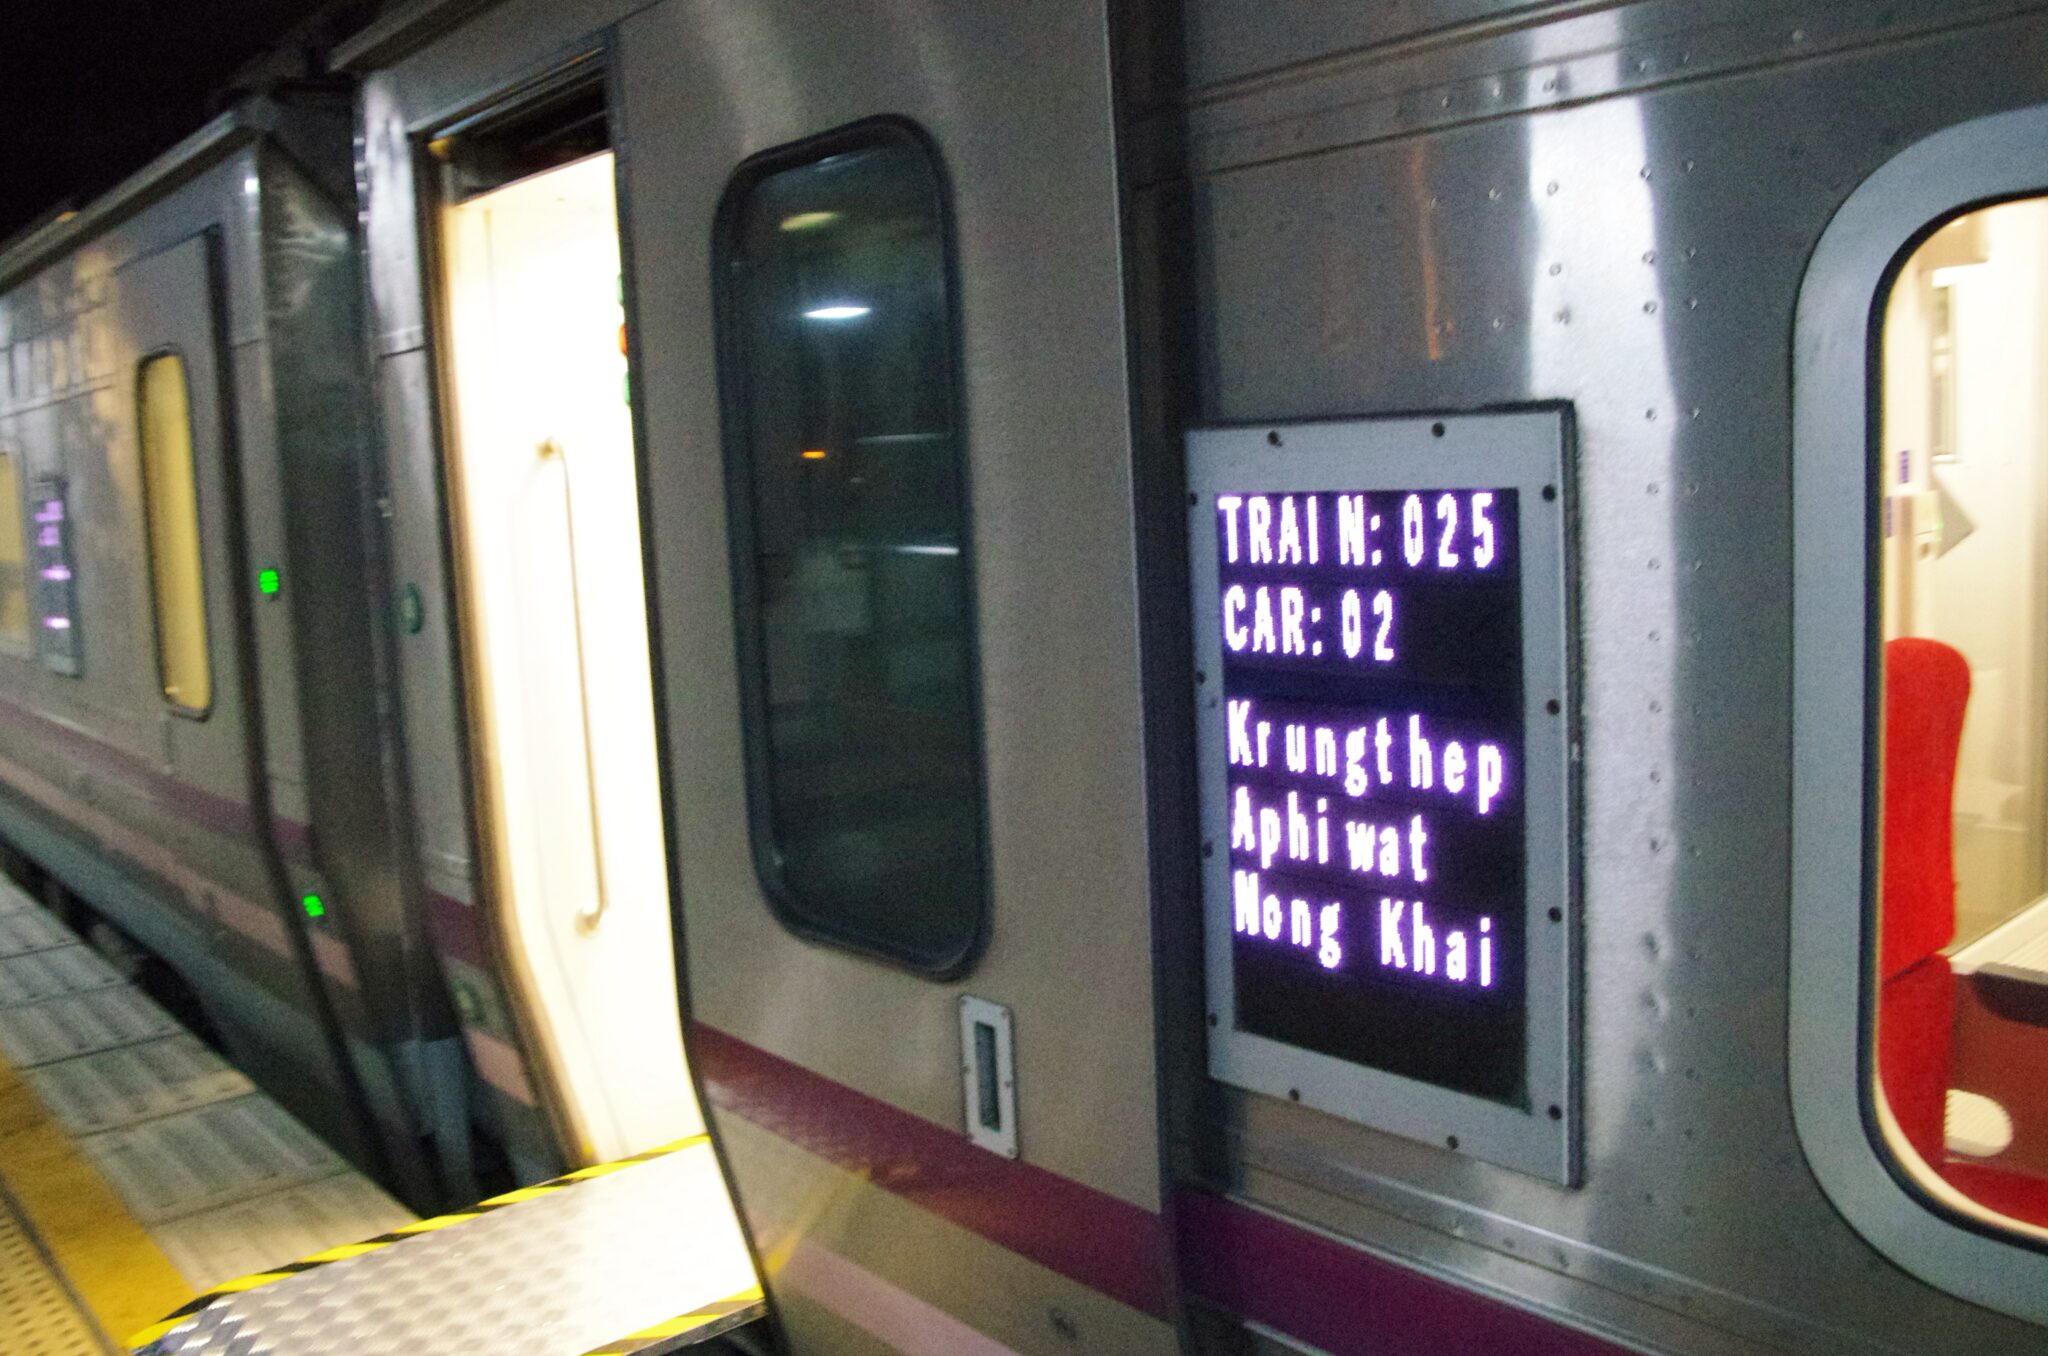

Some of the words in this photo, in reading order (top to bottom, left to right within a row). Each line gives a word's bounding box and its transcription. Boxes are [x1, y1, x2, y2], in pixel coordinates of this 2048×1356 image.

[1217, 494, 1382, 566] TRAIN:
[1401, 491, 1494, 568] 025
[1223, 584, 1322, 656] CAR:
[1340, 588, 1394, 661] 02
[1228, 699, 1502, 815] Krungthep
[1231, 786, 1428, 882] Aphiwat
[1233, 869, 1342, 969] Nong
[1380, 897, 1491, 987] Khai
